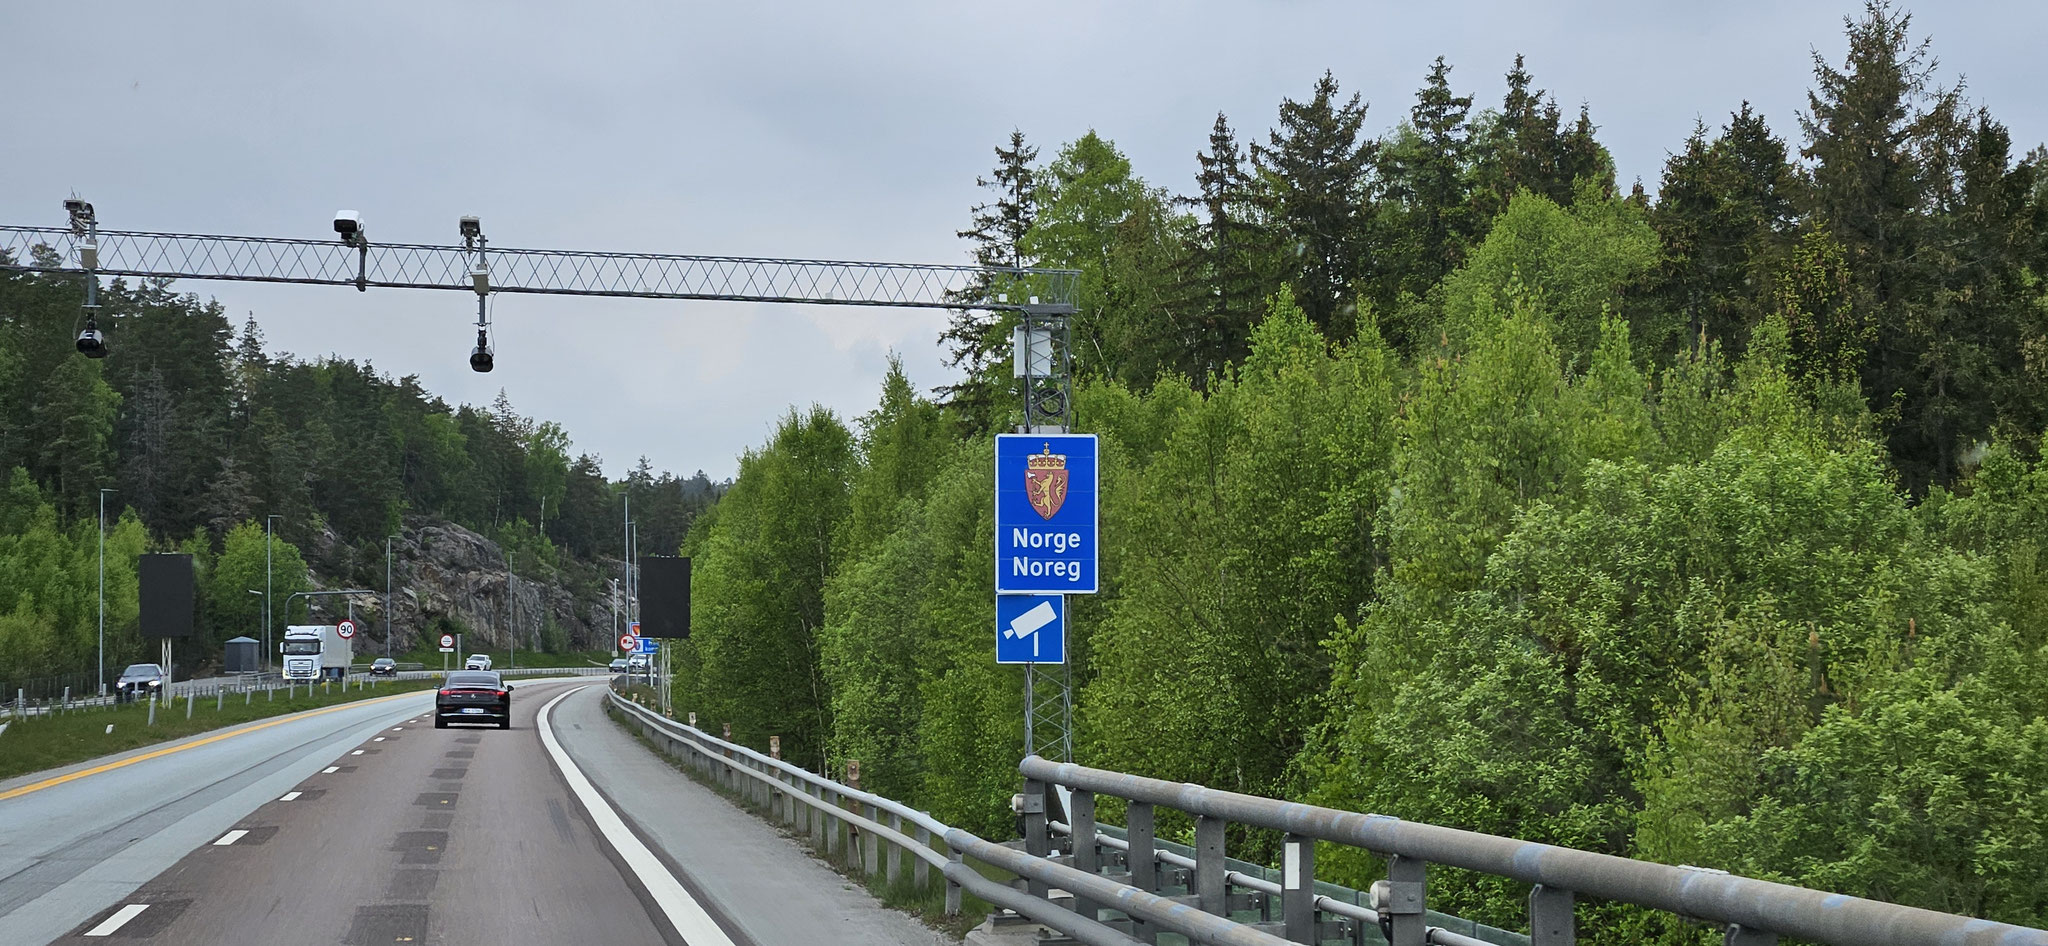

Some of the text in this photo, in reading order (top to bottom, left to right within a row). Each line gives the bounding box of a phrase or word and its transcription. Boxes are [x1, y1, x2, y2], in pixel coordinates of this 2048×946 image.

[1013, 528, 1081, 553] Norge
[1013, 556, 1081, 582] Noreg
[340, 624, 353, 634] 90
